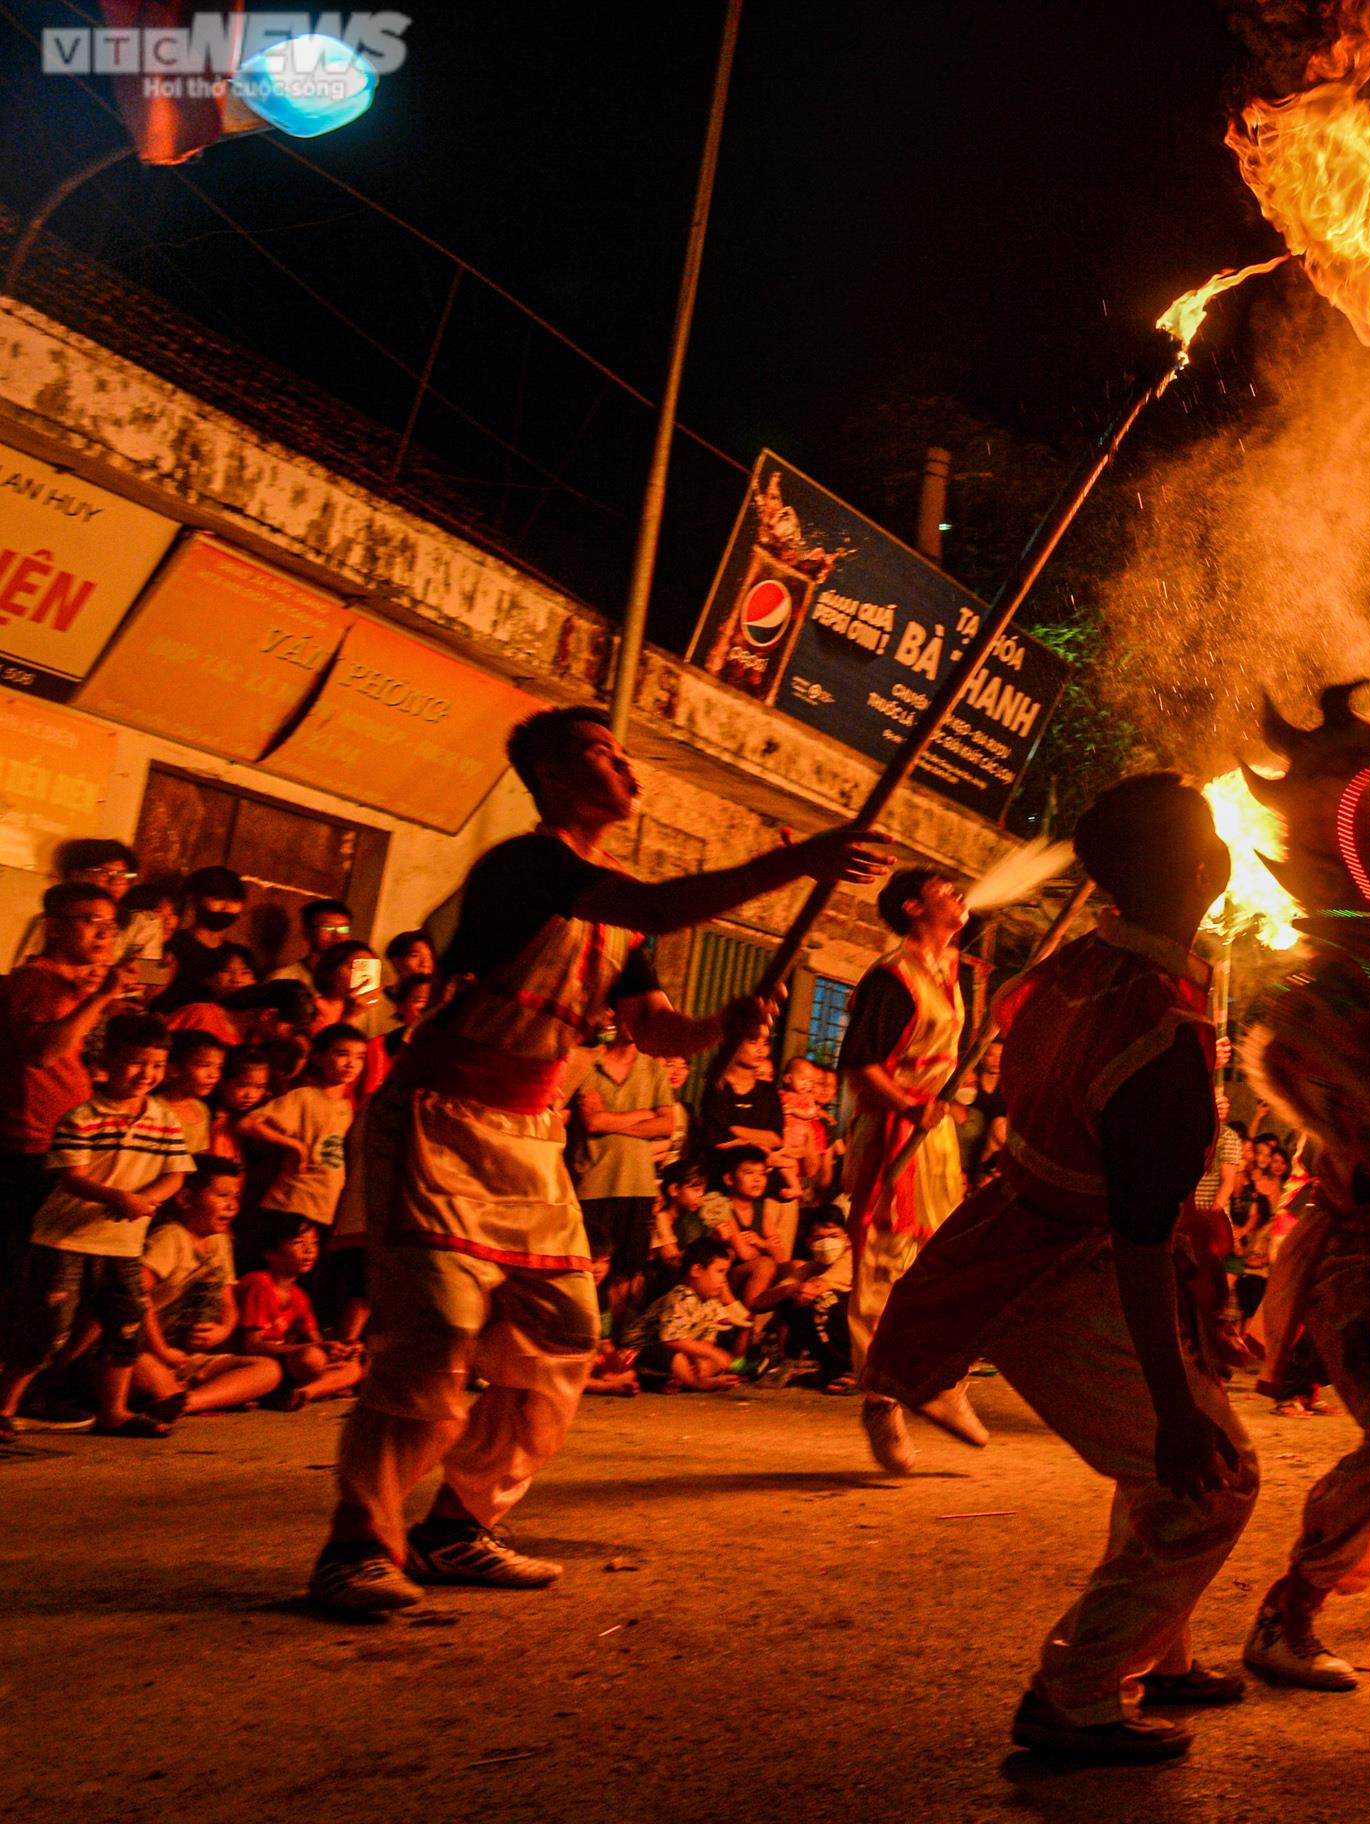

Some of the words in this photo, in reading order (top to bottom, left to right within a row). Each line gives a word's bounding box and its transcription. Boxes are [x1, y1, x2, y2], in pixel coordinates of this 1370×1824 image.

[3, 472, 44, 501] AN
[43, 488, 105, 523] HUY
[894, 622, 946, 681] BÀ
[952, 652, 1042, 738] HANH
